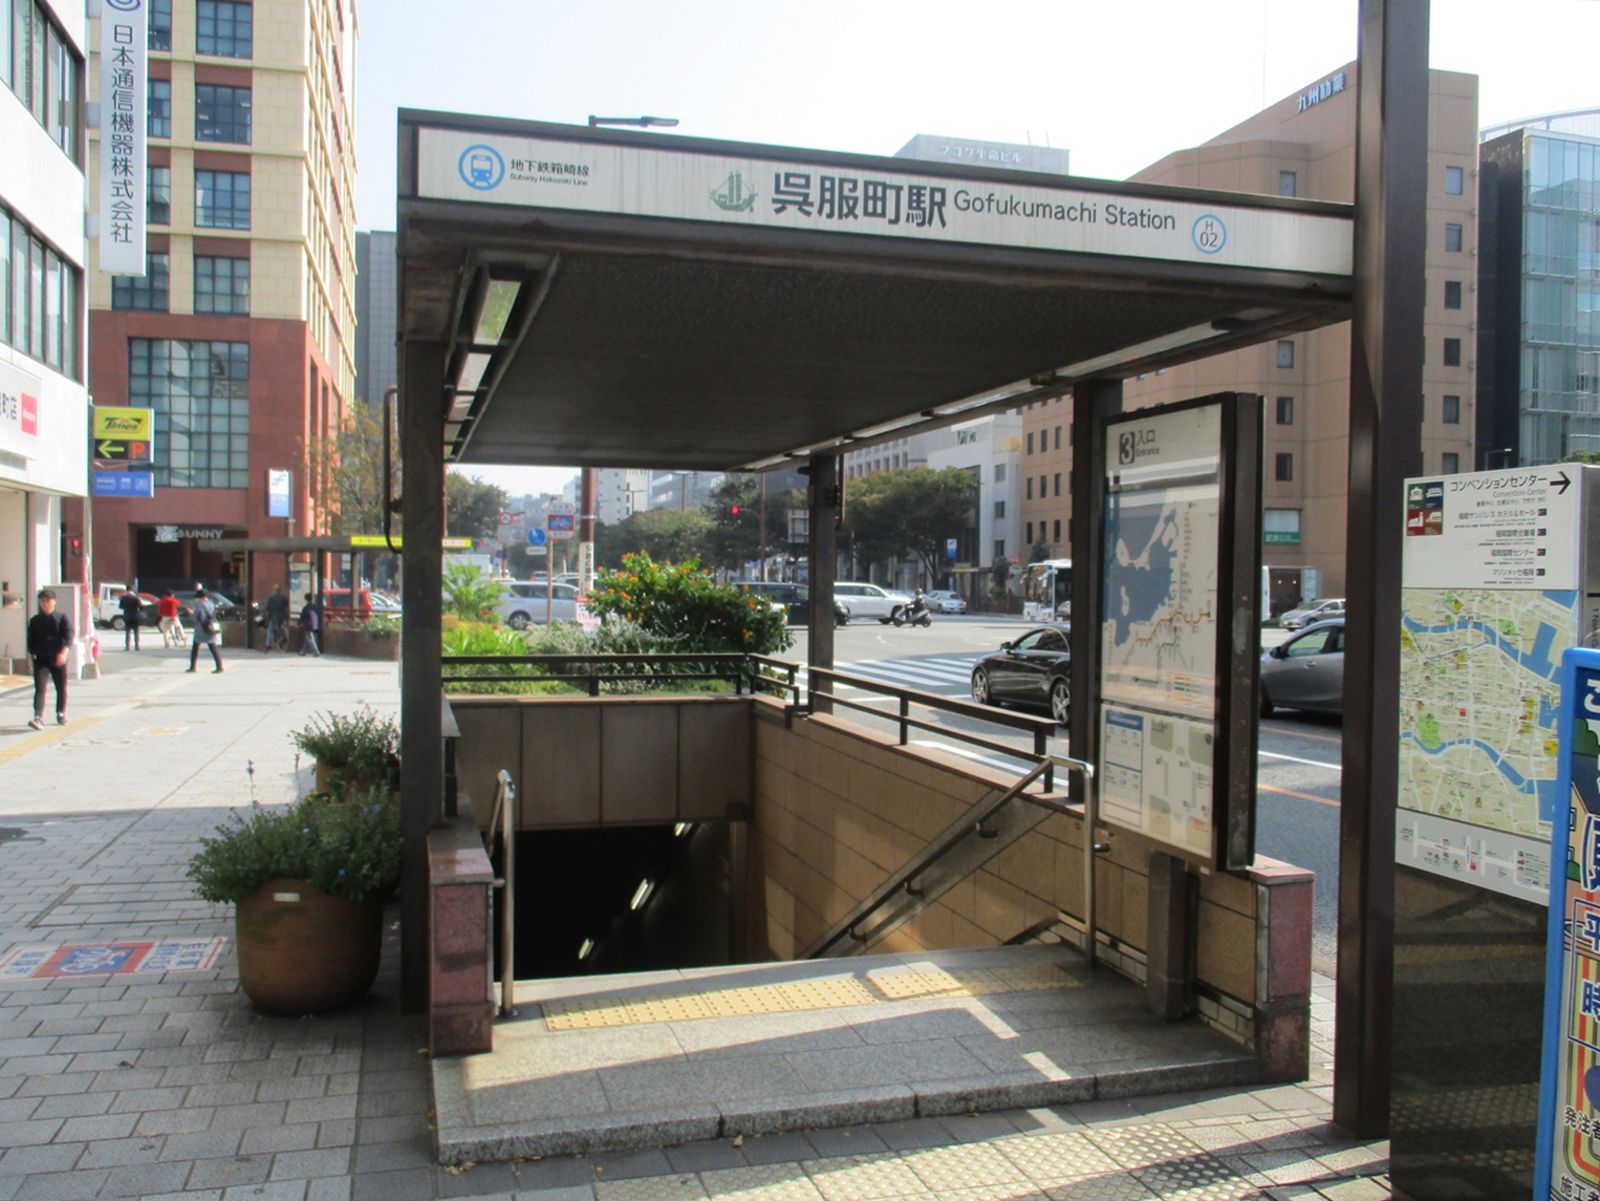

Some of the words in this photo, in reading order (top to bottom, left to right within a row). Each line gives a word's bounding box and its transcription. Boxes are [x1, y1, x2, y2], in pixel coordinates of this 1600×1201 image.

[110, 24, 135, 245] 日本通信機器株式会社
[939, 143, 1023, 163] フコク生命ビル
[510, 157, 590, 177] 地下鉄箱崎線
[573, 179, 588, 187] Line
[771, 172, 947, 229] 呉服町駅
[954, 188, 1098, 225] Gofukumachi
[1104, 204, 1177, 231] Station
[1205, 219, 1214, 231] H
[1199, 231, 1218, 248] 02
[1135, 429, 1156, 446] 入口
[130, 440, 145, 459] P
[1121, 432, 1134, 465] 3
[1450, 474, 1548, 493] コンベンションセンター
[178, 528, 224, 540] SUNNY
